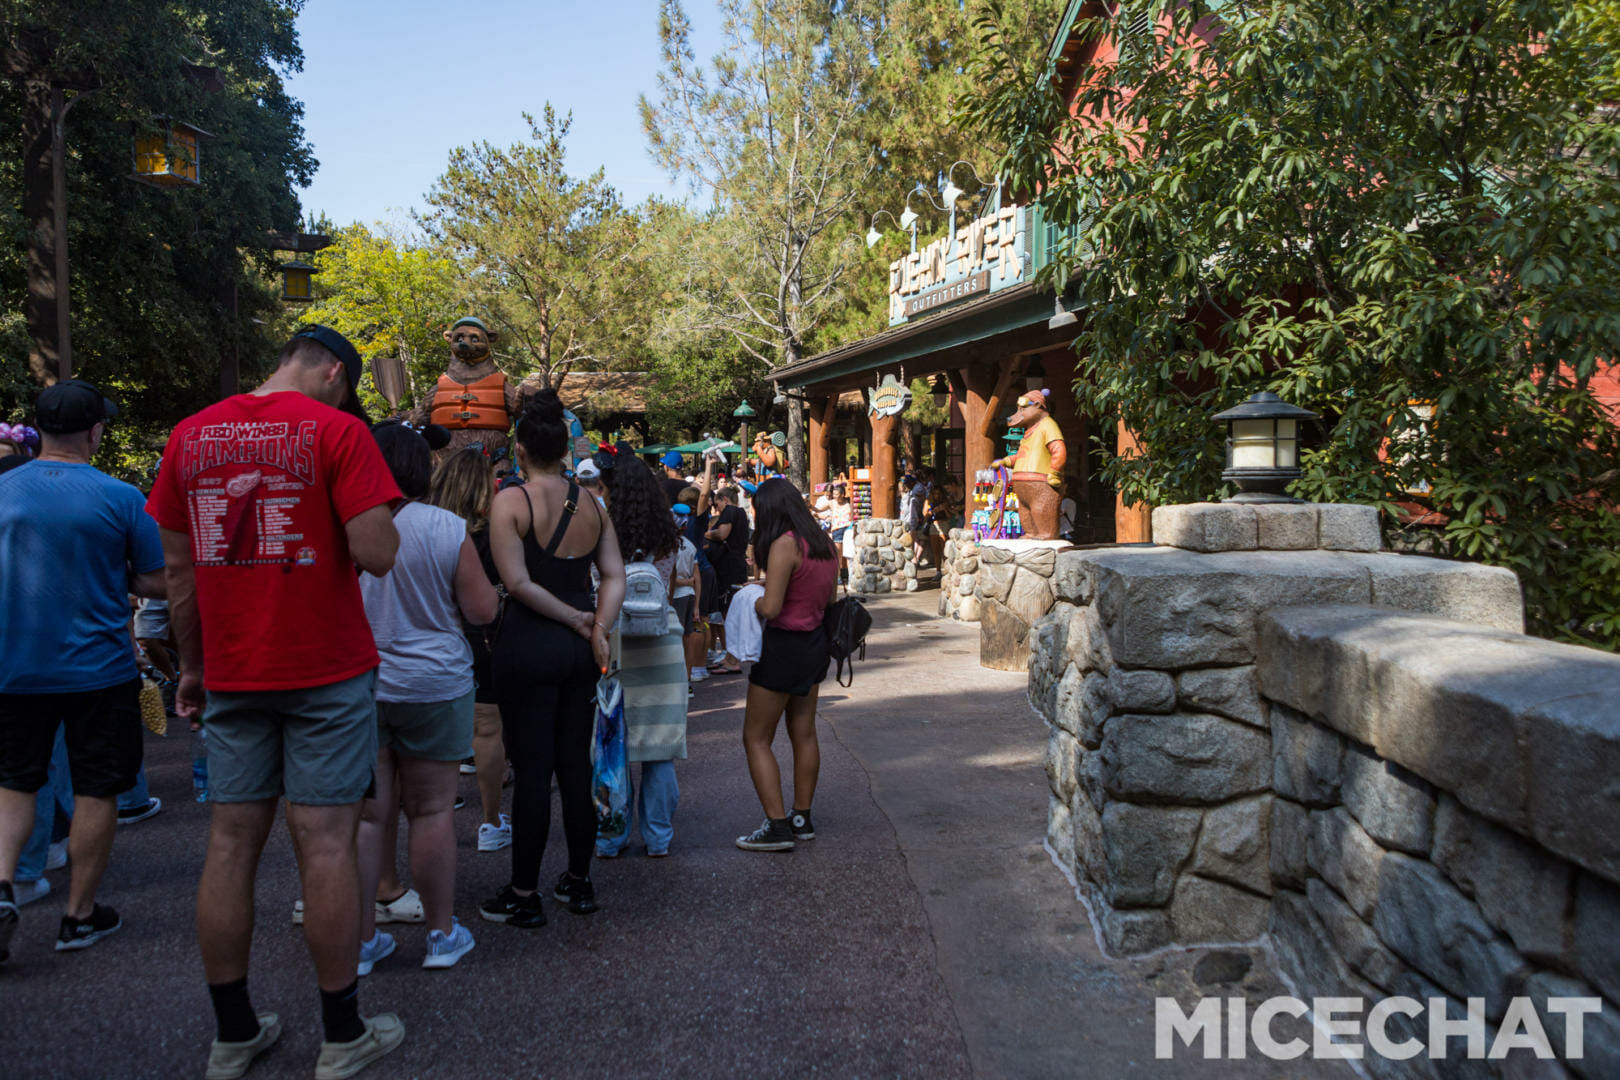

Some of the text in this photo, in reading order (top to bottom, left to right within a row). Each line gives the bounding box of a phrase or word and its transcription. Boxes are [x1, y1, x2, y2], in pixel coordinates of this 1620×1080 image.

[957, 204, 1021, 279] RIVER
[912, 279, 977, 312] OUTFITTERS
[181, 420, 316, 486] CHAMPIONS
[200, 422, 288, 440] RED WINGS
